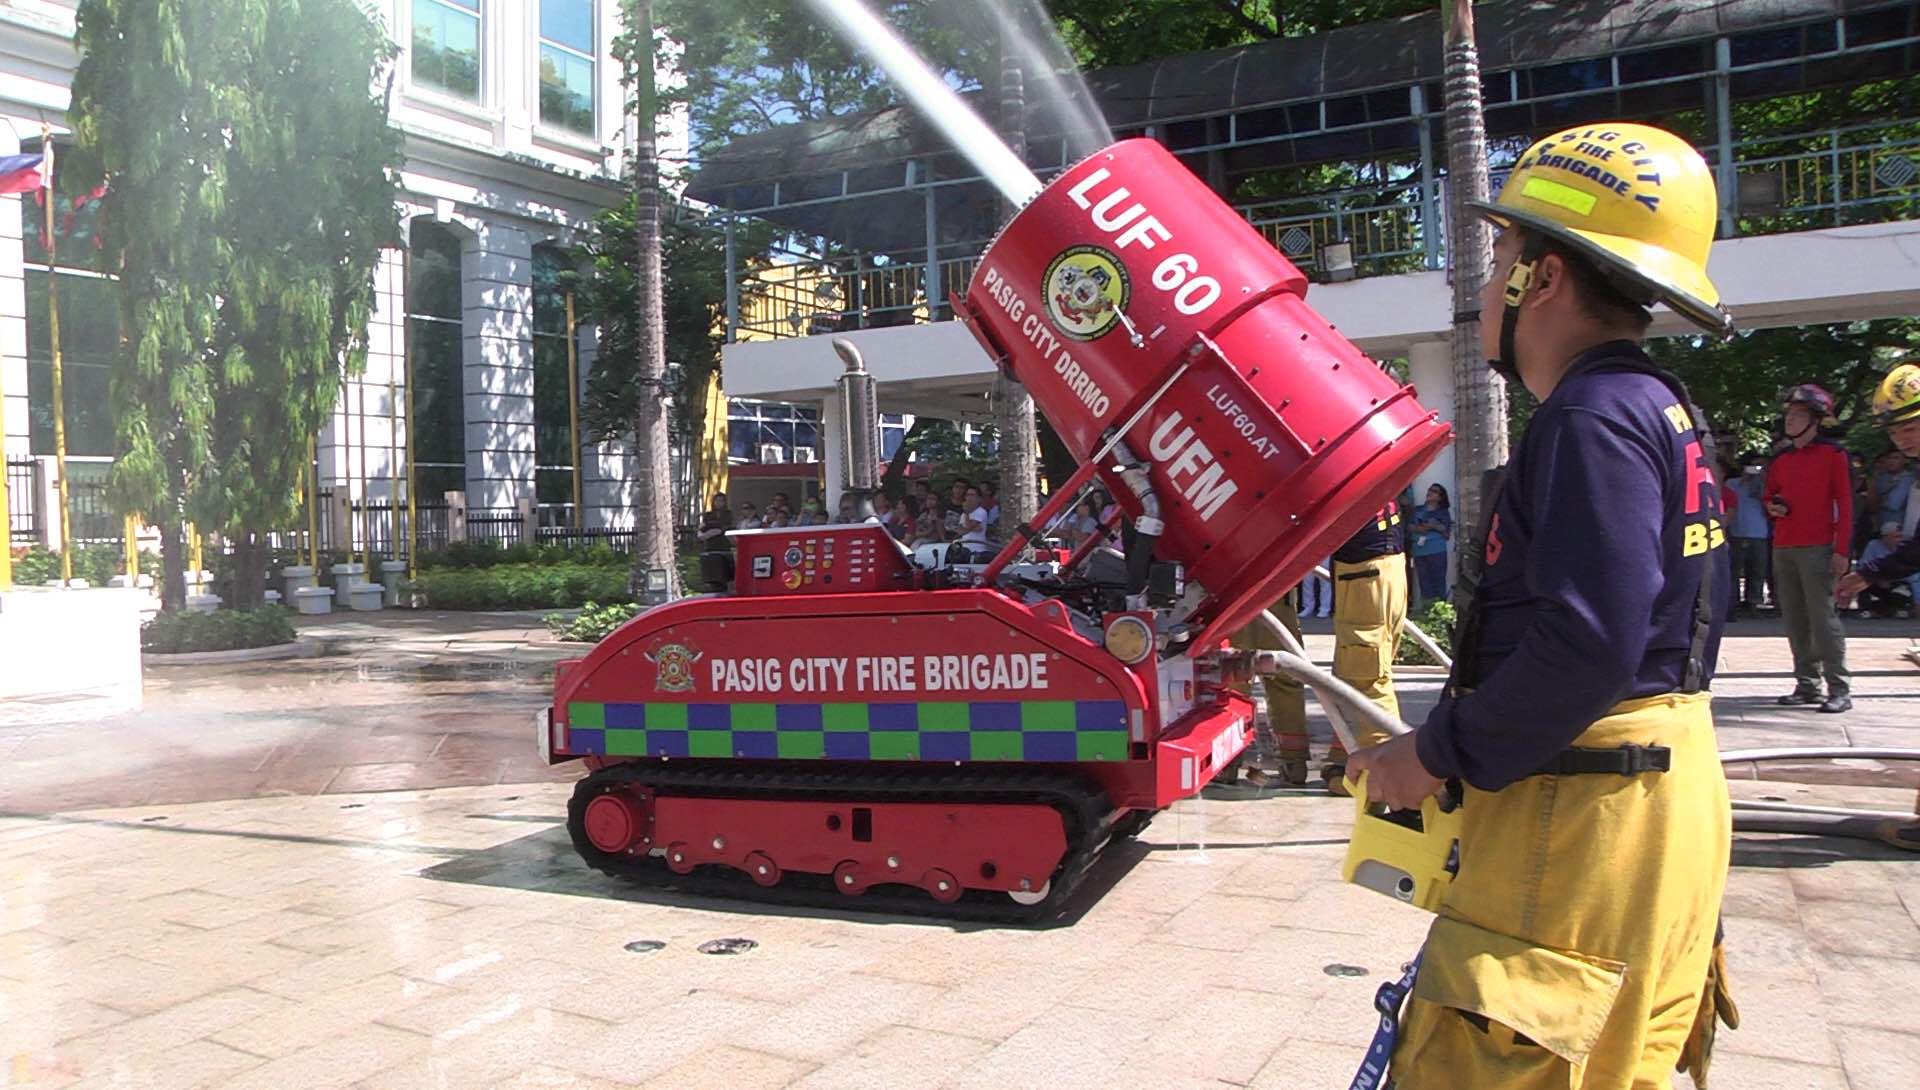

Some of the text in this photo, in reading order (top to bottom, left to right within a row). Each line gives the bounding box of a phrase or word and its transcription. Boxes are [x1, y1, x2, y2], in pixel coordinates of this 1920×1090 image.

[1534, 153, 1631, 198] BRIGADE
[1573, 141, 1616, 162] FIRE
[1066, 167, 1174, 250] LUF
[1152, 253, 1221, 315] 60
[983, 267, 1026, 323] PASIG
[1022, 314, 1061, 359] CITY
[1054, 351, 1110, 418] DRRMO
[1206, 384, 1280, 459] LUF60.AT
[711, 653, 1049, 692] PASIG CITY FIRE BRIGADE
